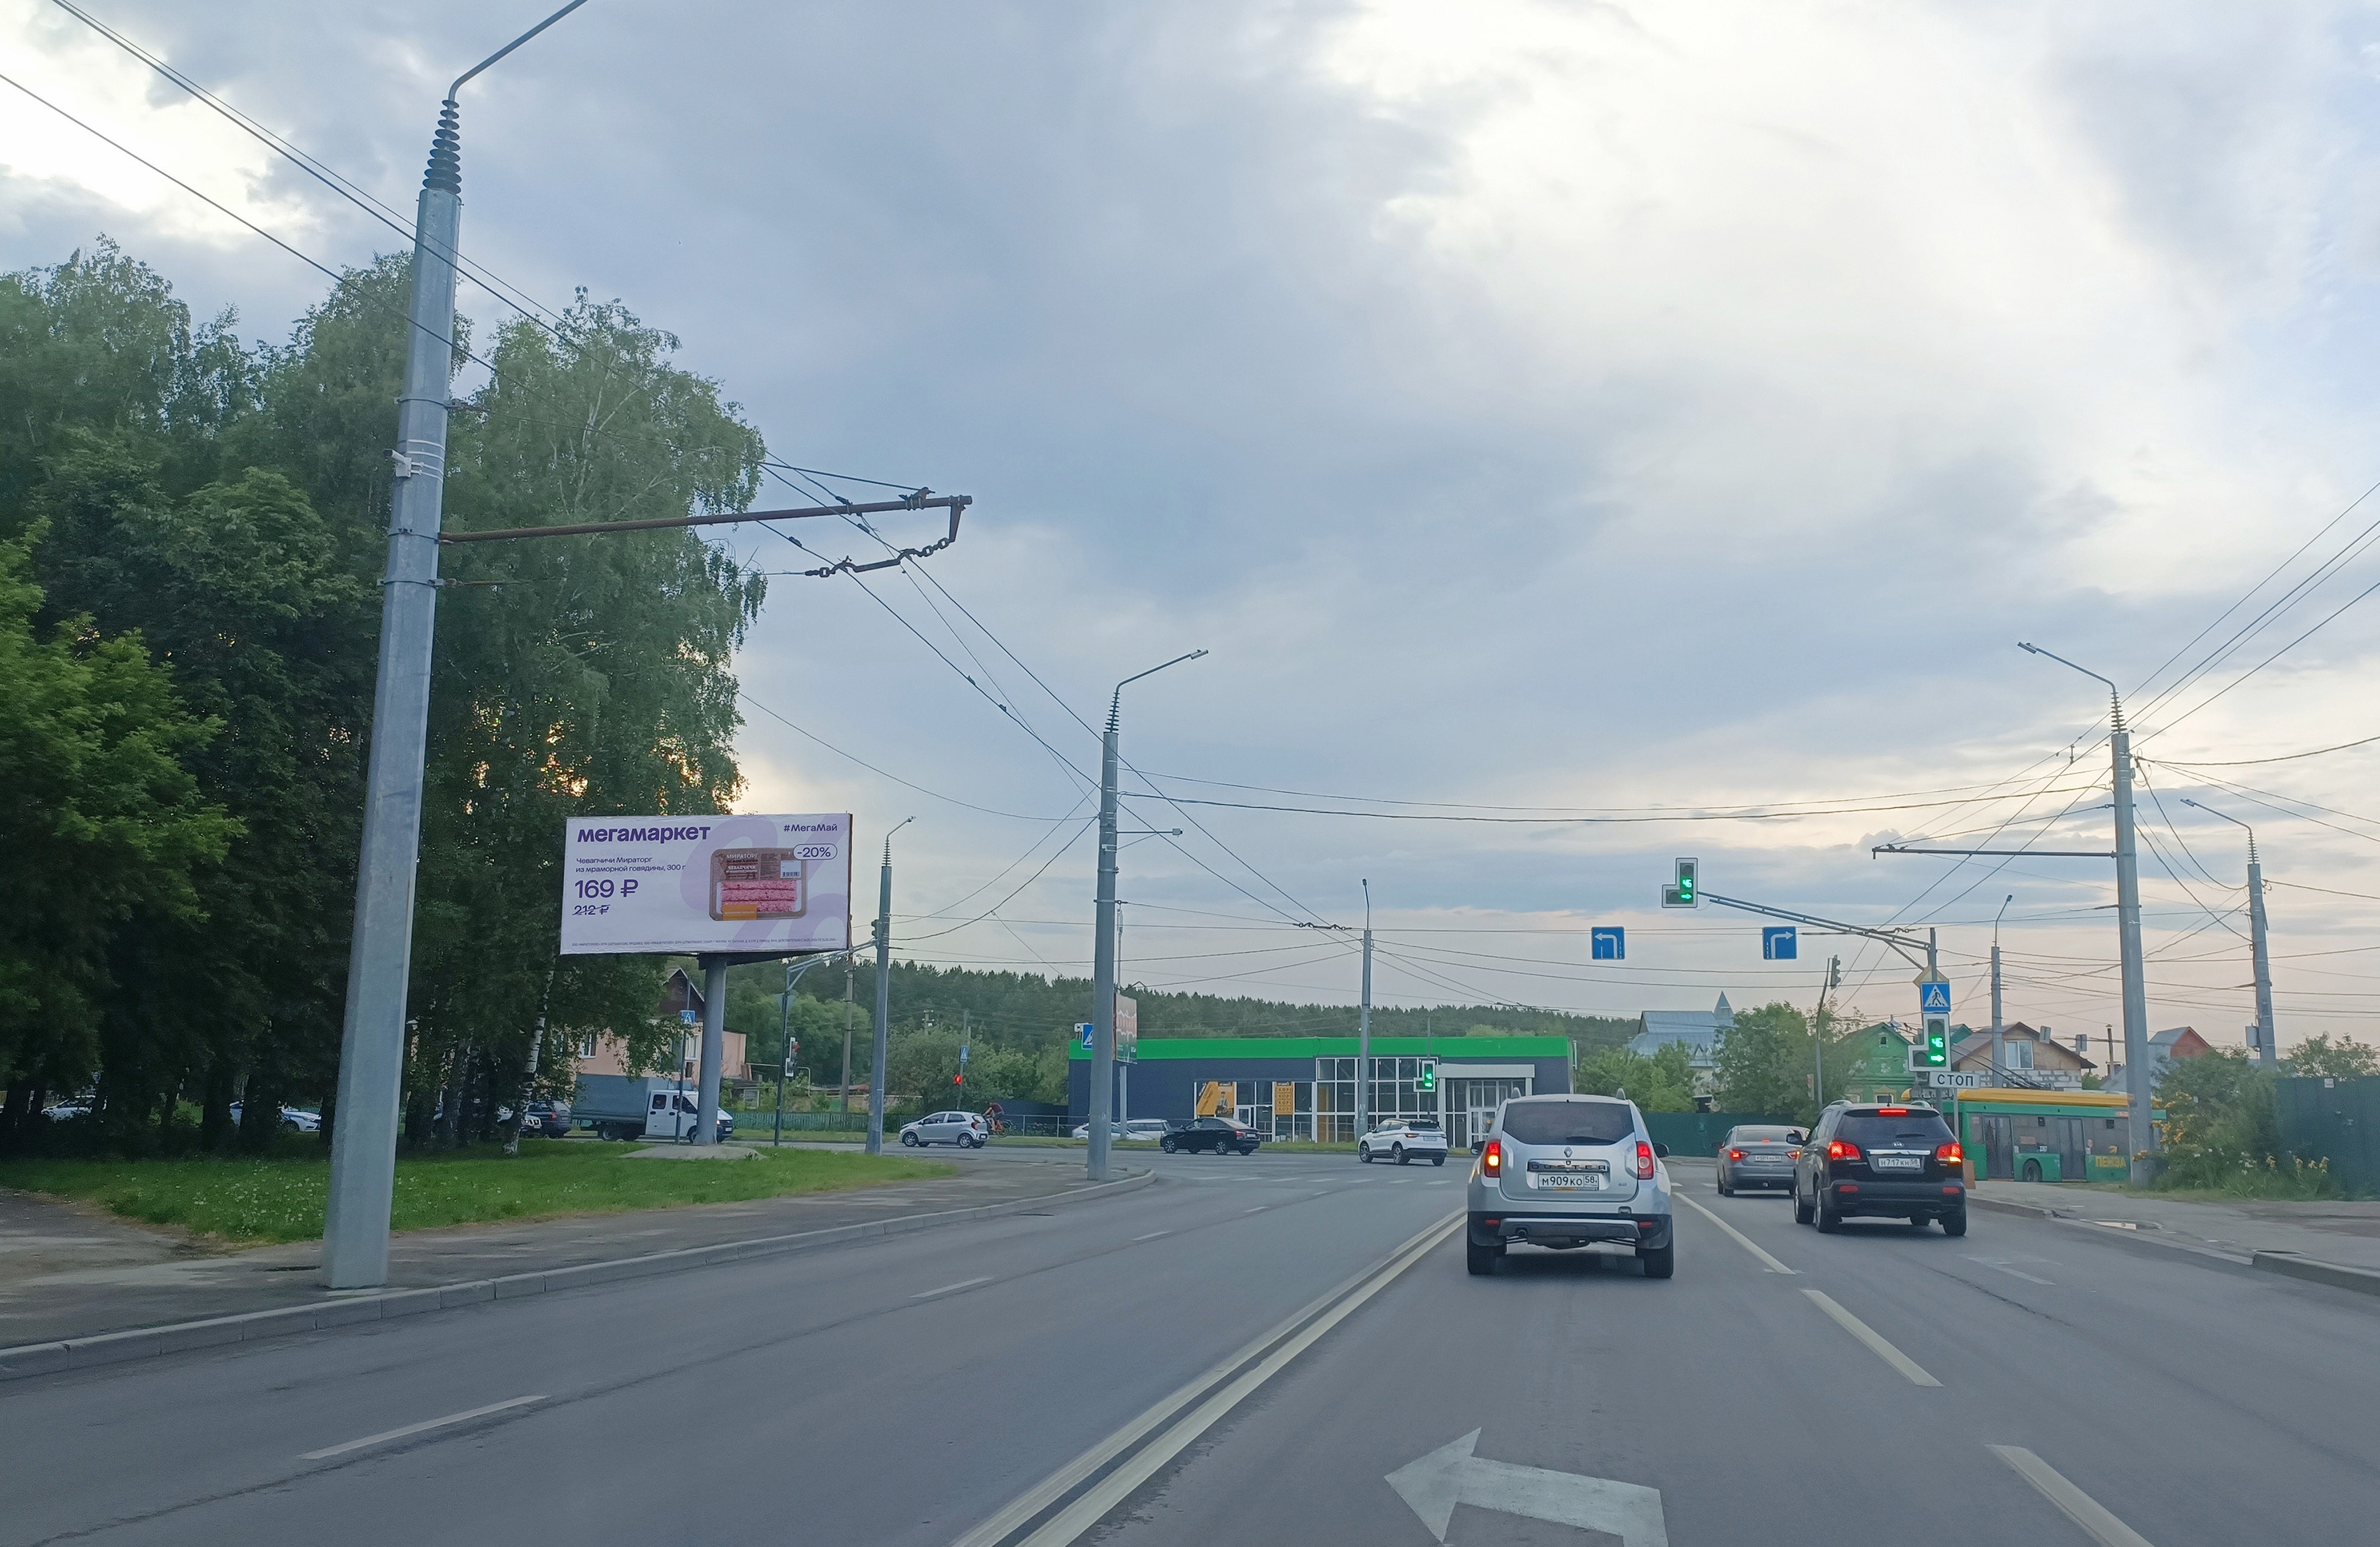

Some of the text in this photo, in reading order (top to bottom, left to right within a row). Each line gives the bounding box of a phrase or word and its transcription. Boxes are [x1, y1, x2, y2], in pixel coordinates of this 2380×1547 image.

[783, 823, 838, 832] #МегаМай
[577, 826, 711, 844] мегамаркет
[797, 846, 831, 857] -20%
[585, 865, 628, 874] мраморной
[574, 878, 614, 899] 169
[572, 904, 596, 916] 212
[1937, 1074, 1974, 1087] СТОП
